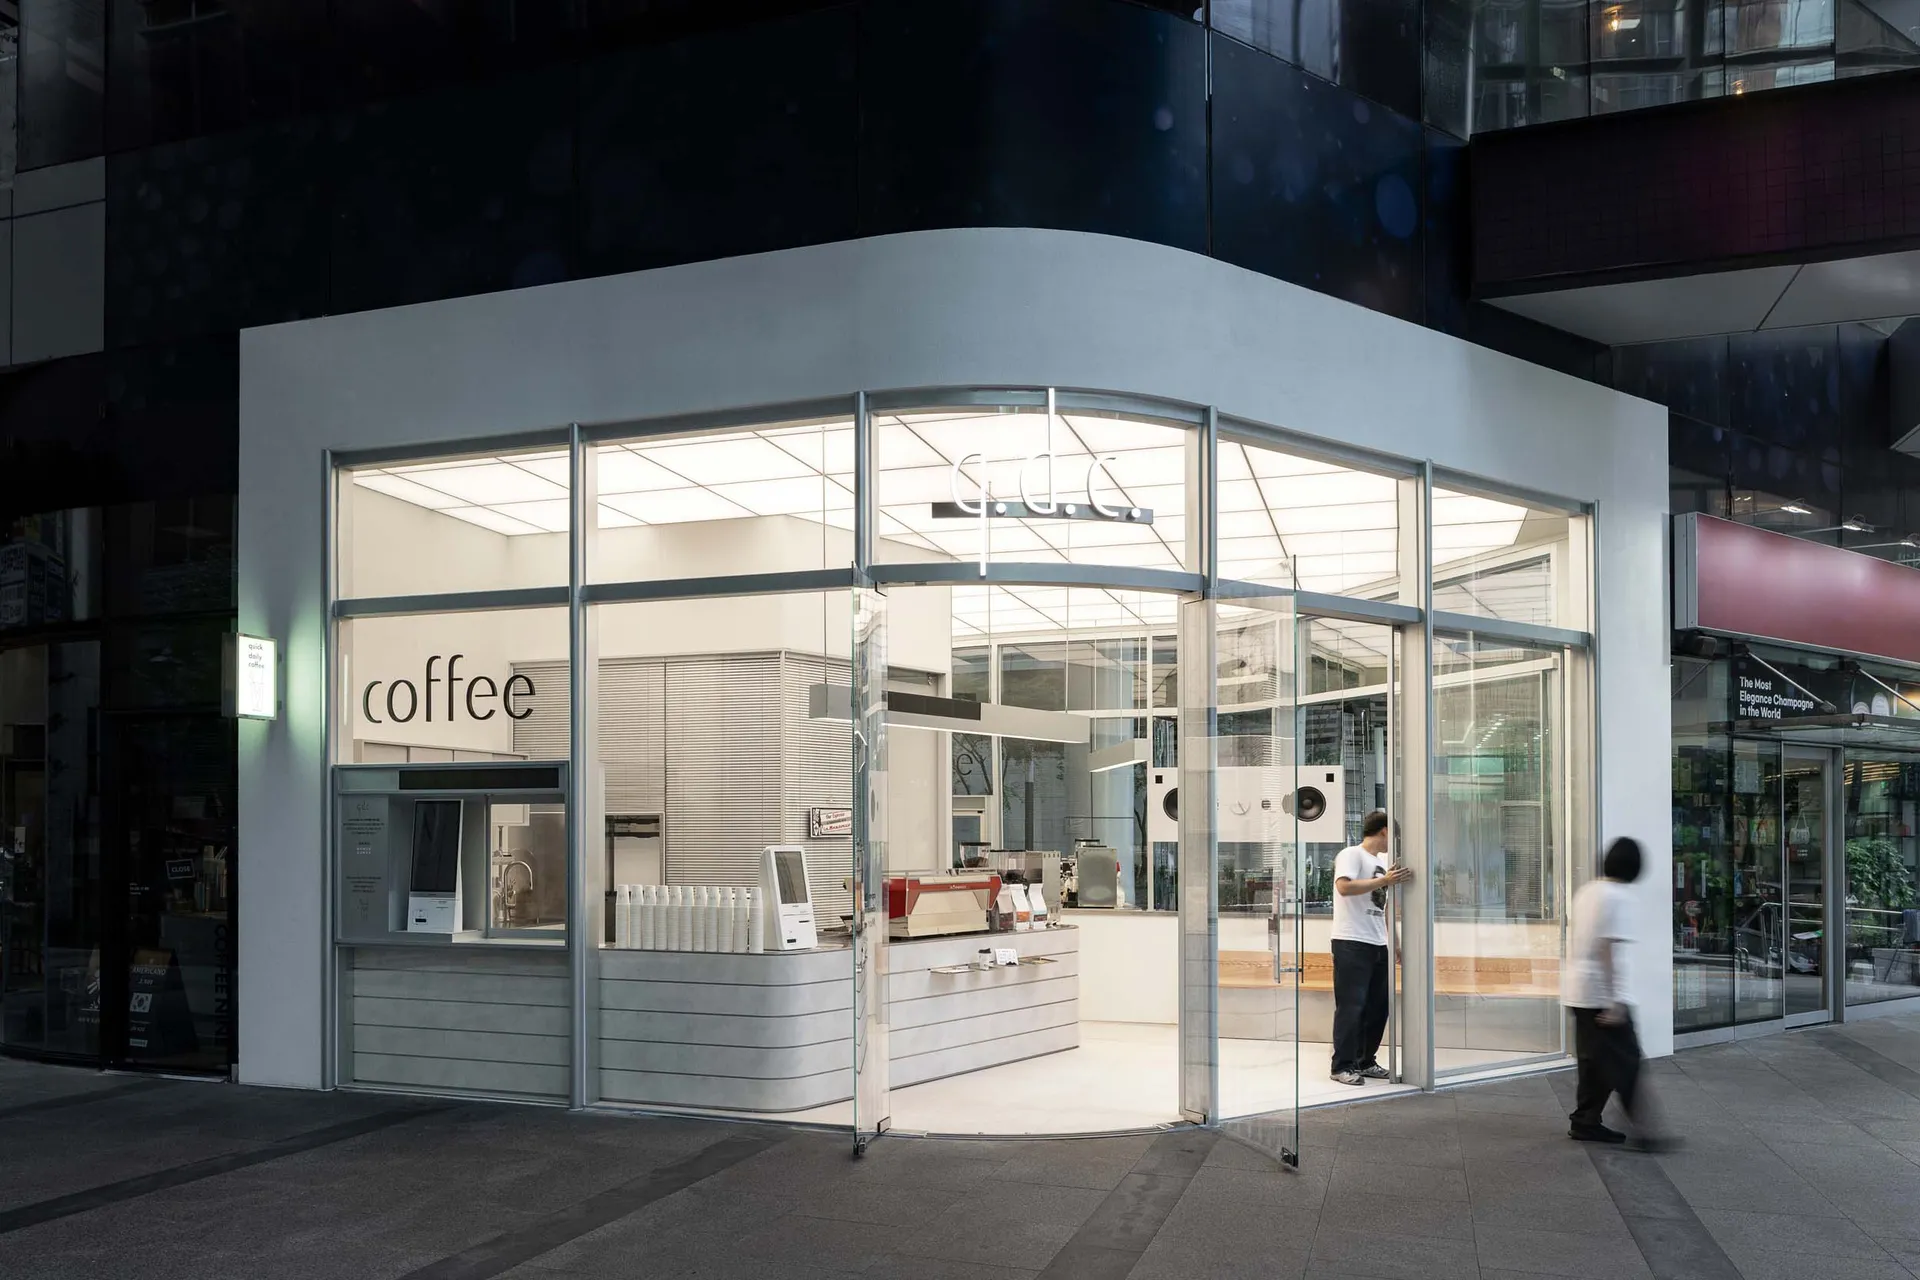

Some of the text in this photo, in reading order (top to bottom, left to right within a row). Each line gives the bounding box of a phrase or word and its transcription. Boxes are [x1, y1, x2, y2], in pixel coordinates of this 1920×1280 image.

[248, 643, 263, 651] quick
[248, 652, 263, 662] daily
[362, 654, 536, 724] coffee
[1739, 676, 1773, 691] The Most
[1739, 690, 1814, 711] Elegance Champagne
[1739, 704, 1782, 719] in the World
